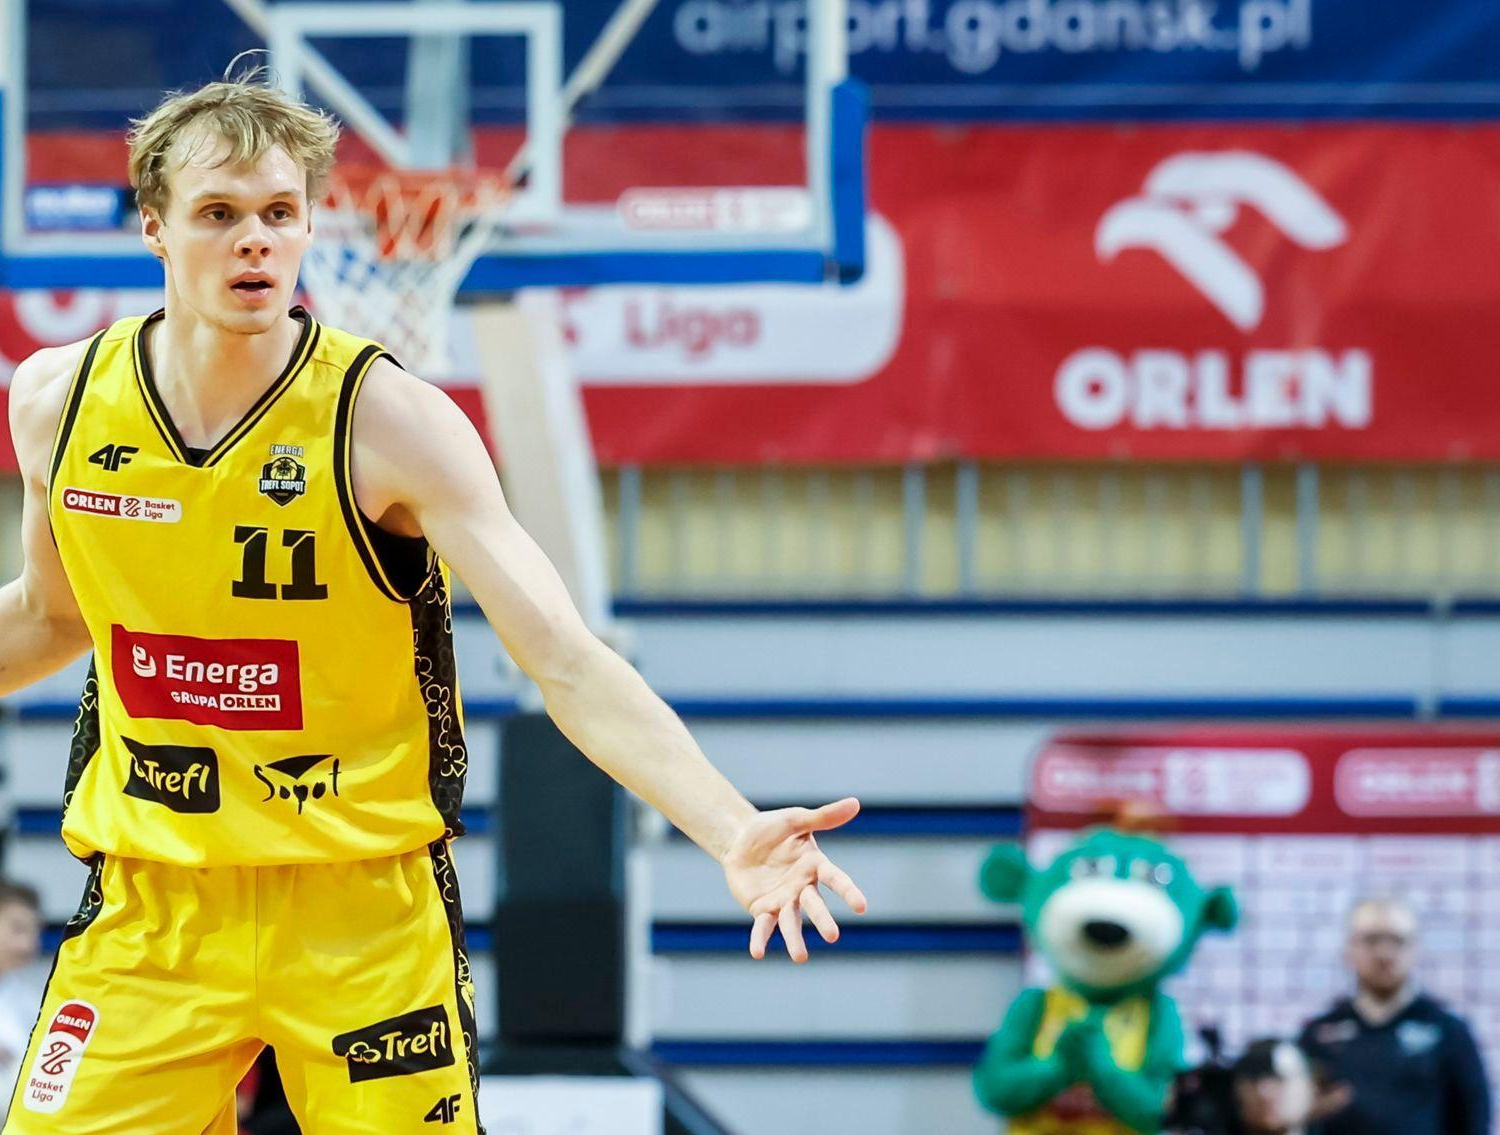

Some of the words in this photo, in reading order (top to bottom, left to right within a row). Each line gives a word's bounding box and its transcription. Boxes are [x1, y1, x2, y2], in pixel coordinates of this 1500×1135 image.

[624, 290, 762, 360] Liga
[1054, 346, 1373, 431] ORLEN
[88, 444, 140, 472] 4F
[271, 445, 304, 457] ENERGA
[261, 480, 279, 491] TREFL
[281, 481, 304, 493] SOPOT
[66, 493, 116, 512] ORLEN
[144, 500, 175, 511] Basket
[144, 510, 163, 520] Liga
[231, 525, 329, 600] 11
[166, 654, 279, 692] Energa
[171, 691, 219, 709] GRUPA
[223, 693, 277, 709] ORLEN
[145, 761, 211, 800] Trefl
[254, 758, 342, 815] Sopot
[56, 1014, 91, 1030] ORLEN
[380, 1021, 447, 1061] Trefl
[30, 1078, 64, 1093] Basket
[31, 1089, 54, 1103] Liga
[423, 1093, 462, 1124] 4F
